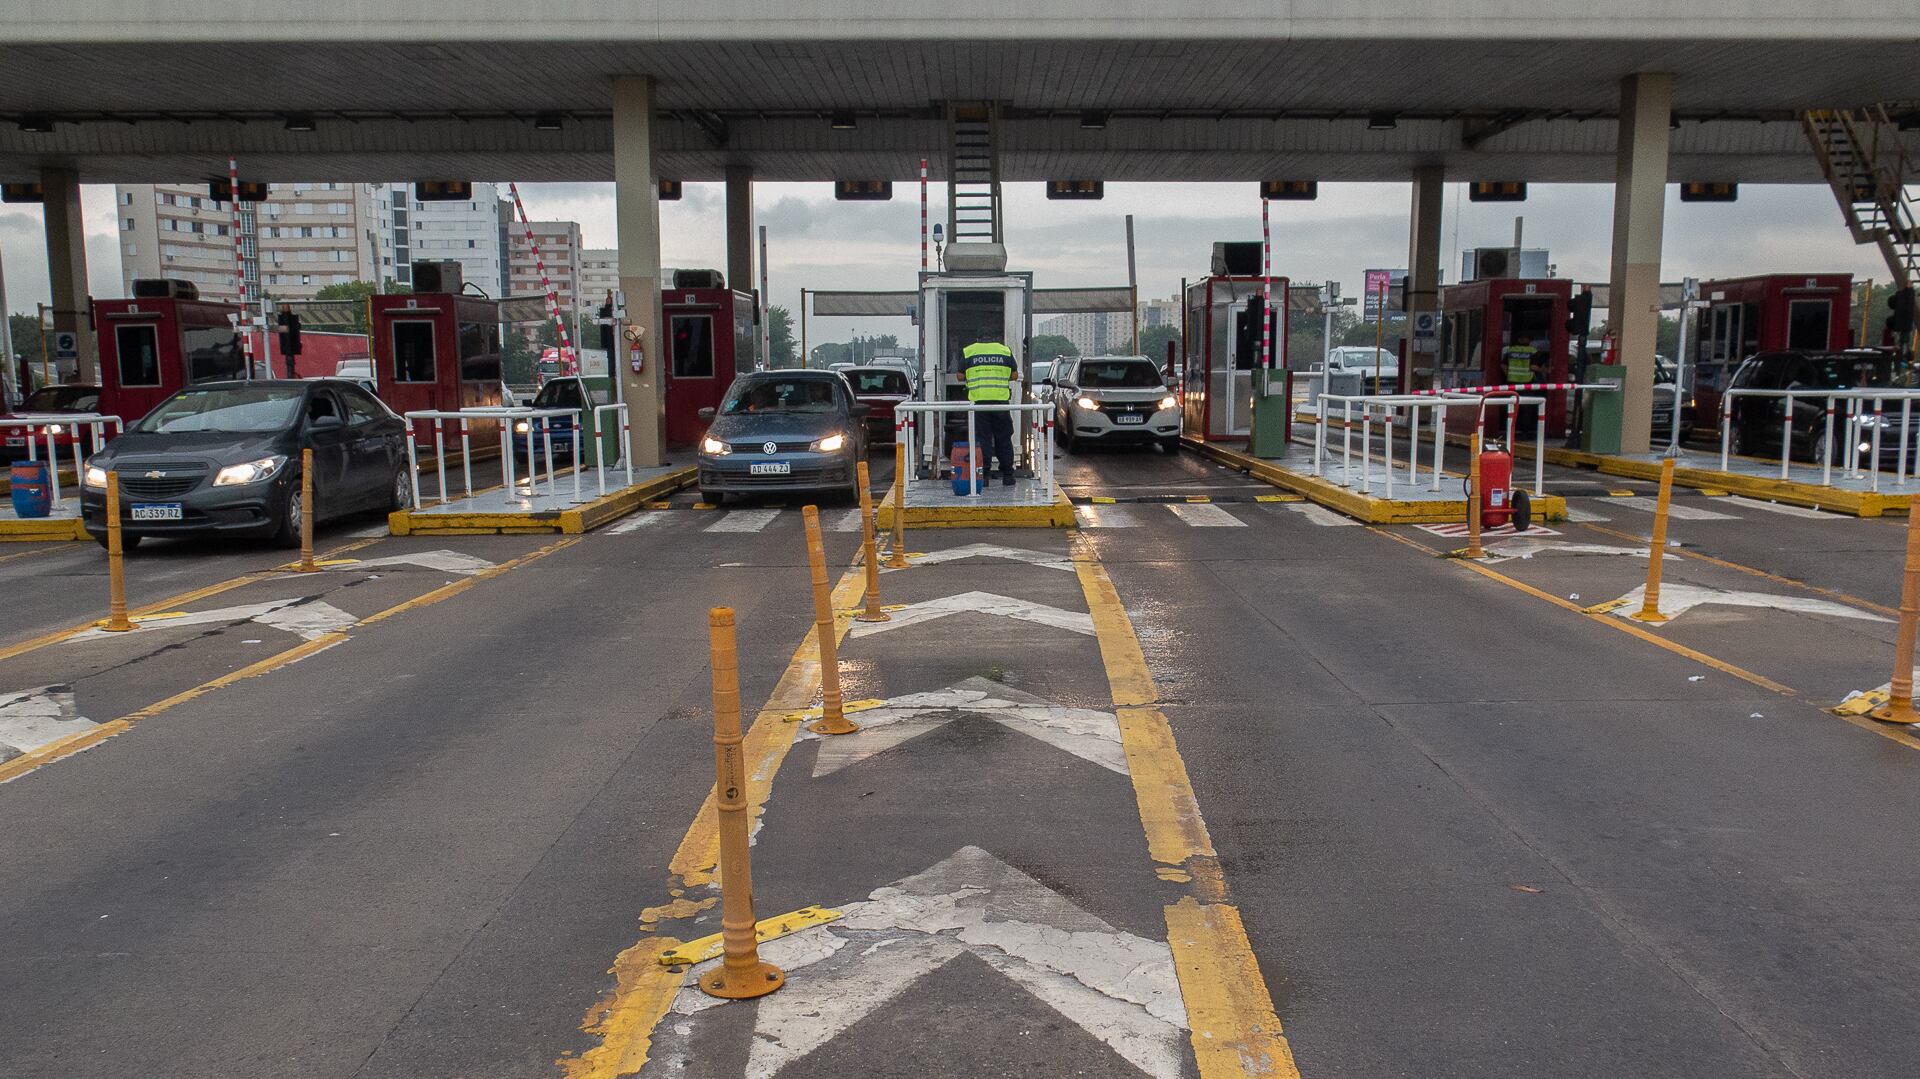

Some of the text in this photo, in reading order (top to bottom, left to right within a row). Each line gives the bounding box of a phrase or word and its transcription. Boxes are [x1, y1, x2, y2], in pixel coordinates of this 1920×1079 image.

[973, 356, 1004, 364] POLICIA
[752, 465, 762, 473] AD
[763, 465, 777, 473] 444
[134, 508, 180, 519] AC 339 RZ
